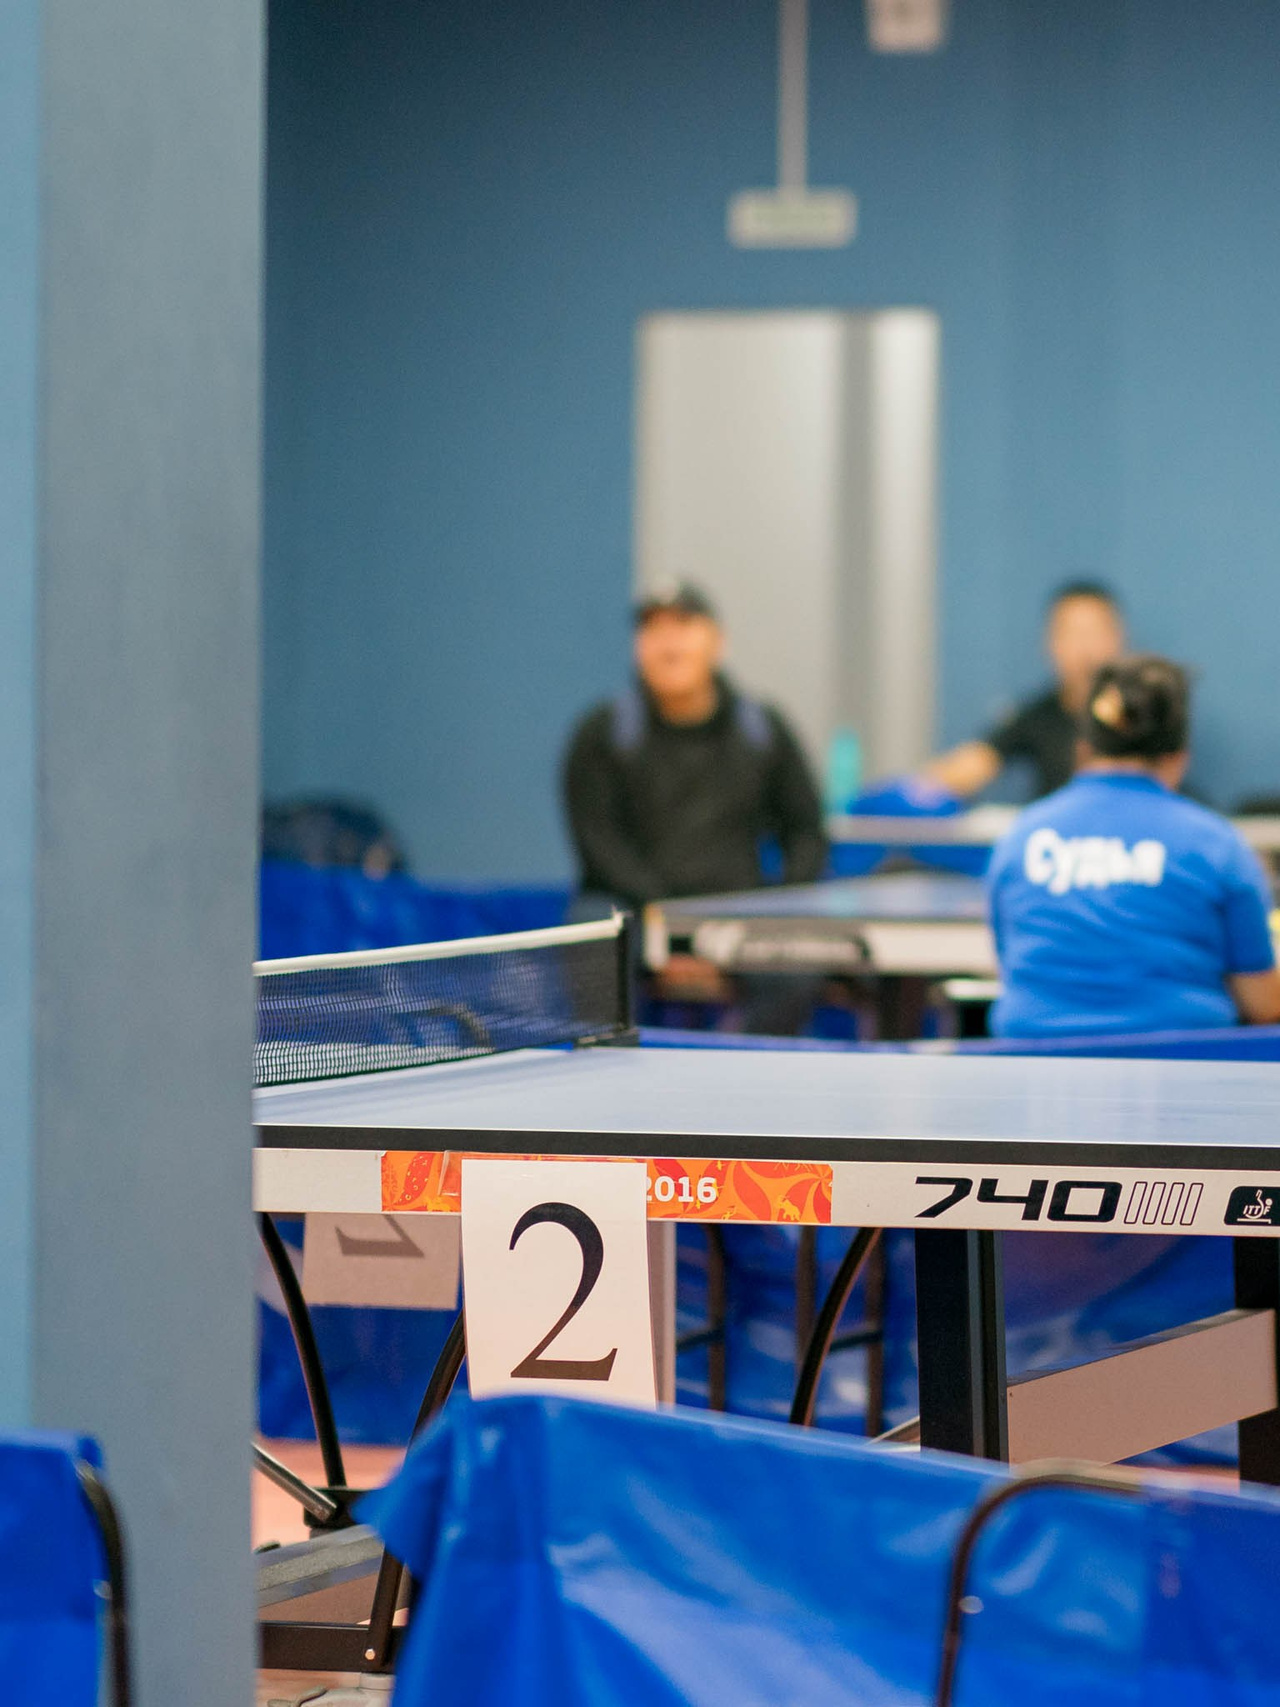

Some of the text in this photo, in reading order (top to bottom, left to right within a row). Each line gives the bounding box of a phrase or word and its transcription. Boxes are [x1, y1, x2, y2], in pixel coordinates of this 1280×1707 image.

[914, 1176, 1122, 1223] 740
[1243, 1205, 1271, 1215] ITTF
[509, 1202, 618, 1381] 2
